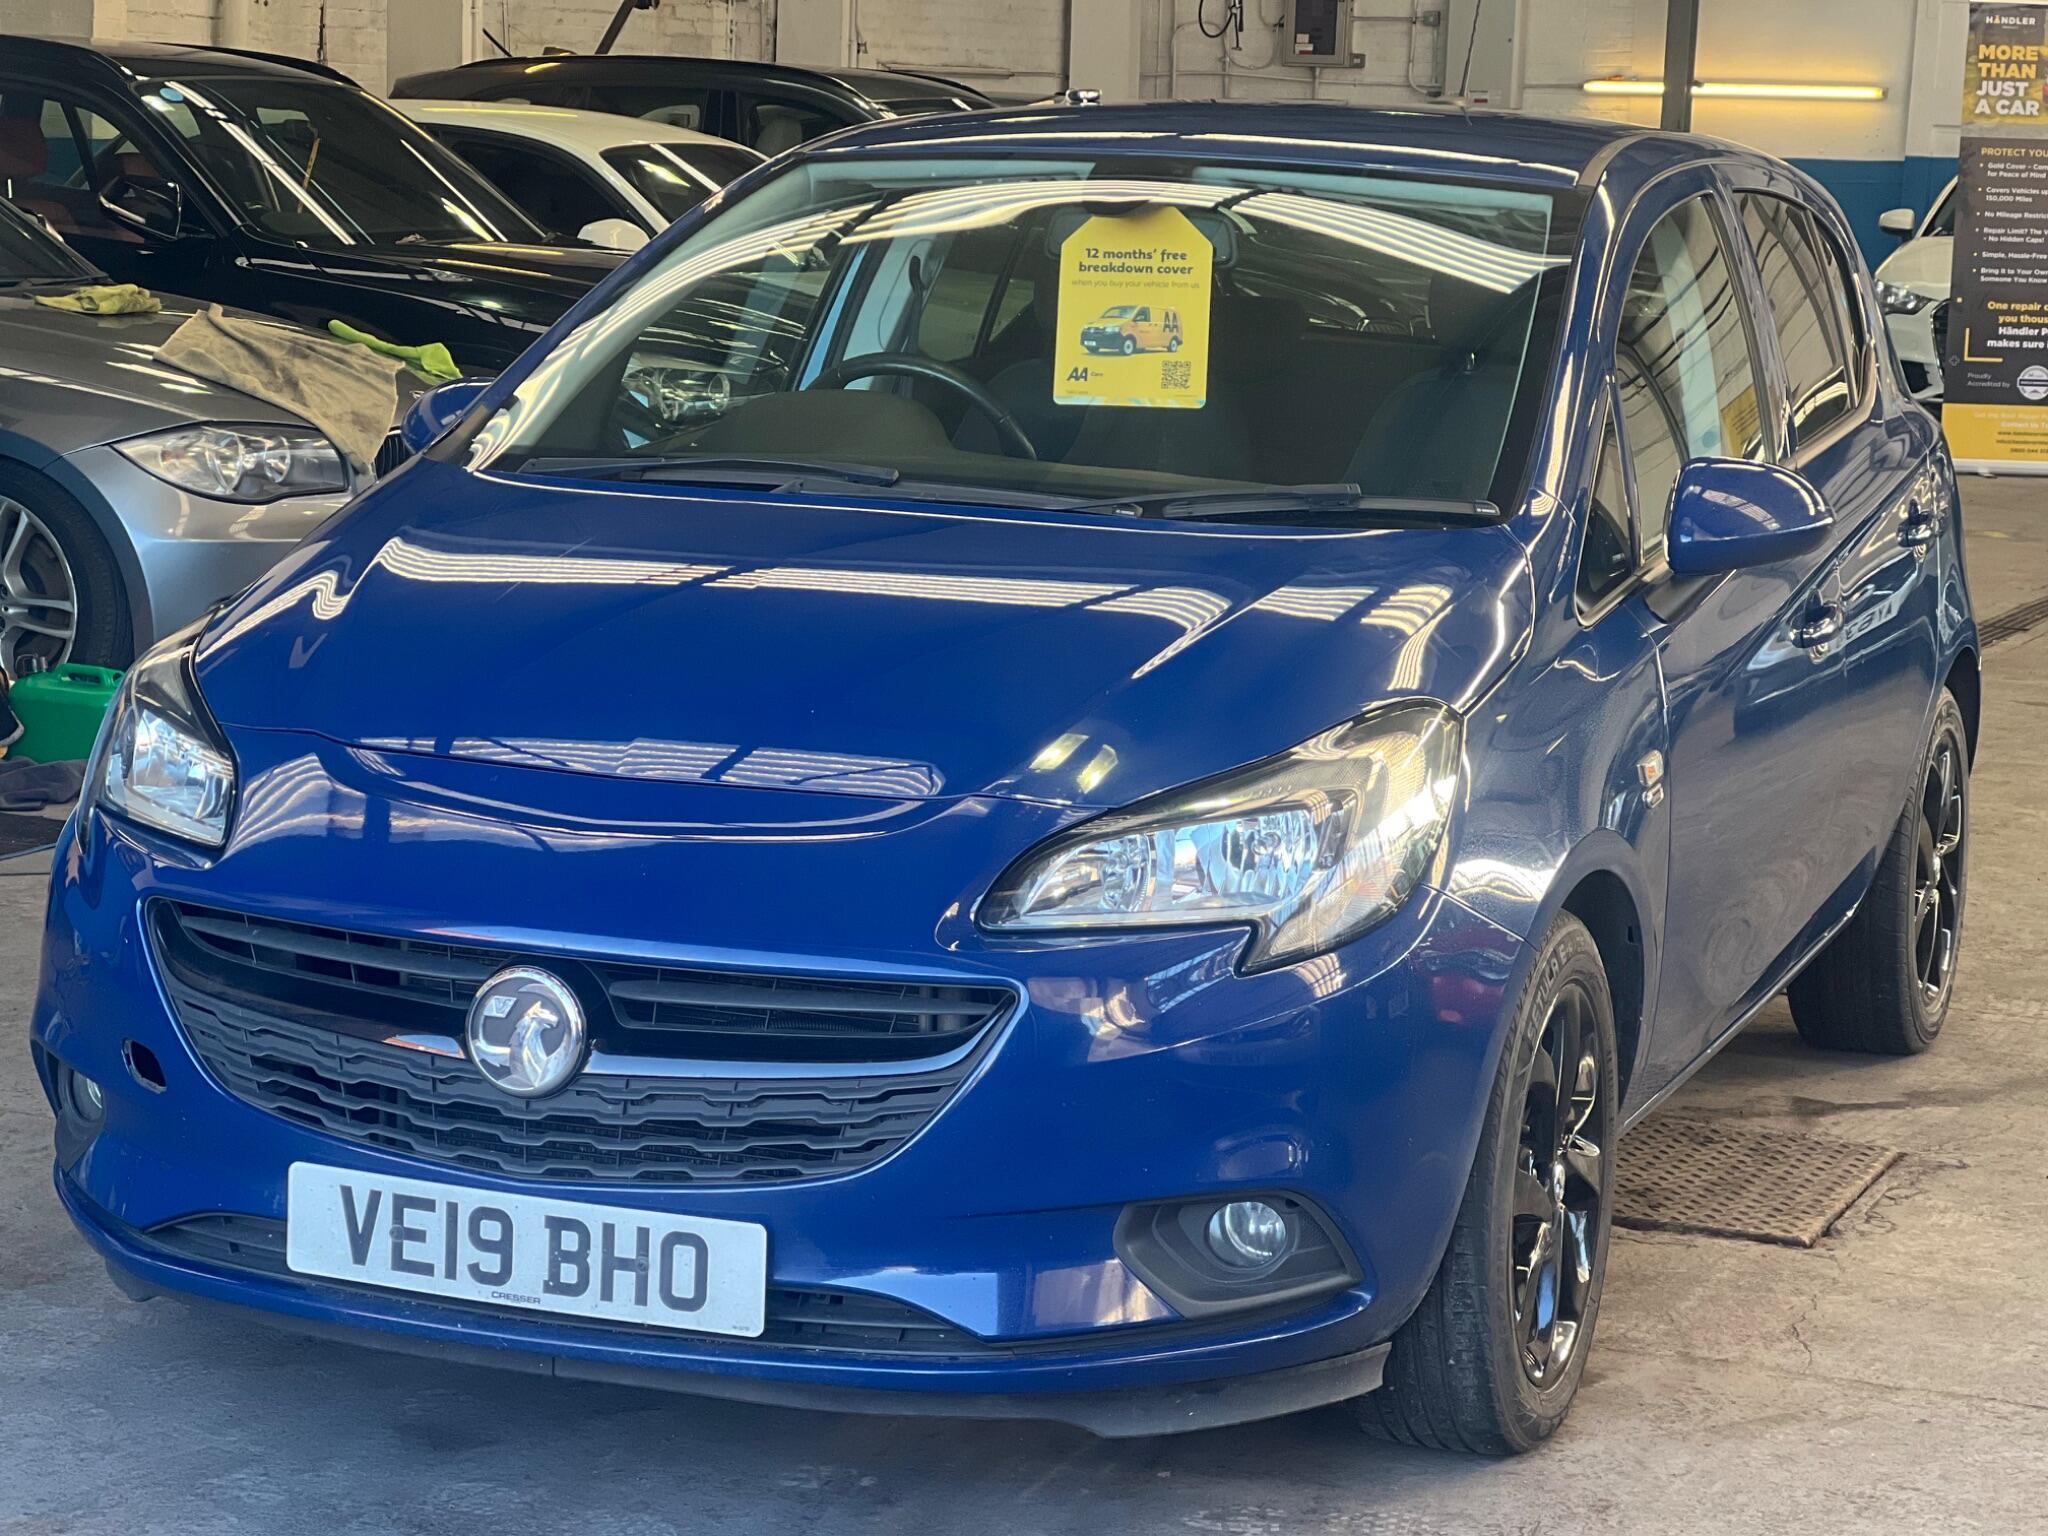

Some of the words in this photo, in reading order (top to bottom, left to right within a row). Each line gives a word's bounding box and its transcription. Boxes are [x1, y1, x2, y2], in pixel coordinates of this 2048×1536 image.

[1979, 44, 2038, 60] MORE
[1978, 62, 2037, 79] THAN
[1976, 80, 2029, 97] JUST
[1974, 98, 1991, 114] A
[1996, 100, 2040, 116] CAR
[1981, 147, 2026, 156] PROTECT
[1086, 248, 1098, 258] 12
[1161, 249, 1187, 262] free
[1078, 262, 1152, 274] breakdown
[1157, 266, 1194, 274] cover
[1109, 280, 1124, 288] buy
[1988, 301, 2008, 310] One
[2011, 302, 2042, 312] repair
[1163, 312, 1180, 332] AA
[1998, 315, 2018, 324] you
[1987, 339, 2020, 348] makes
[1066, 367, 1088, 381] AA
[340, 1184, 514, 1288] VE19
[542, 1215, 709, 1312] BHO
[490, 1290, 541, 1306] CRESSER
